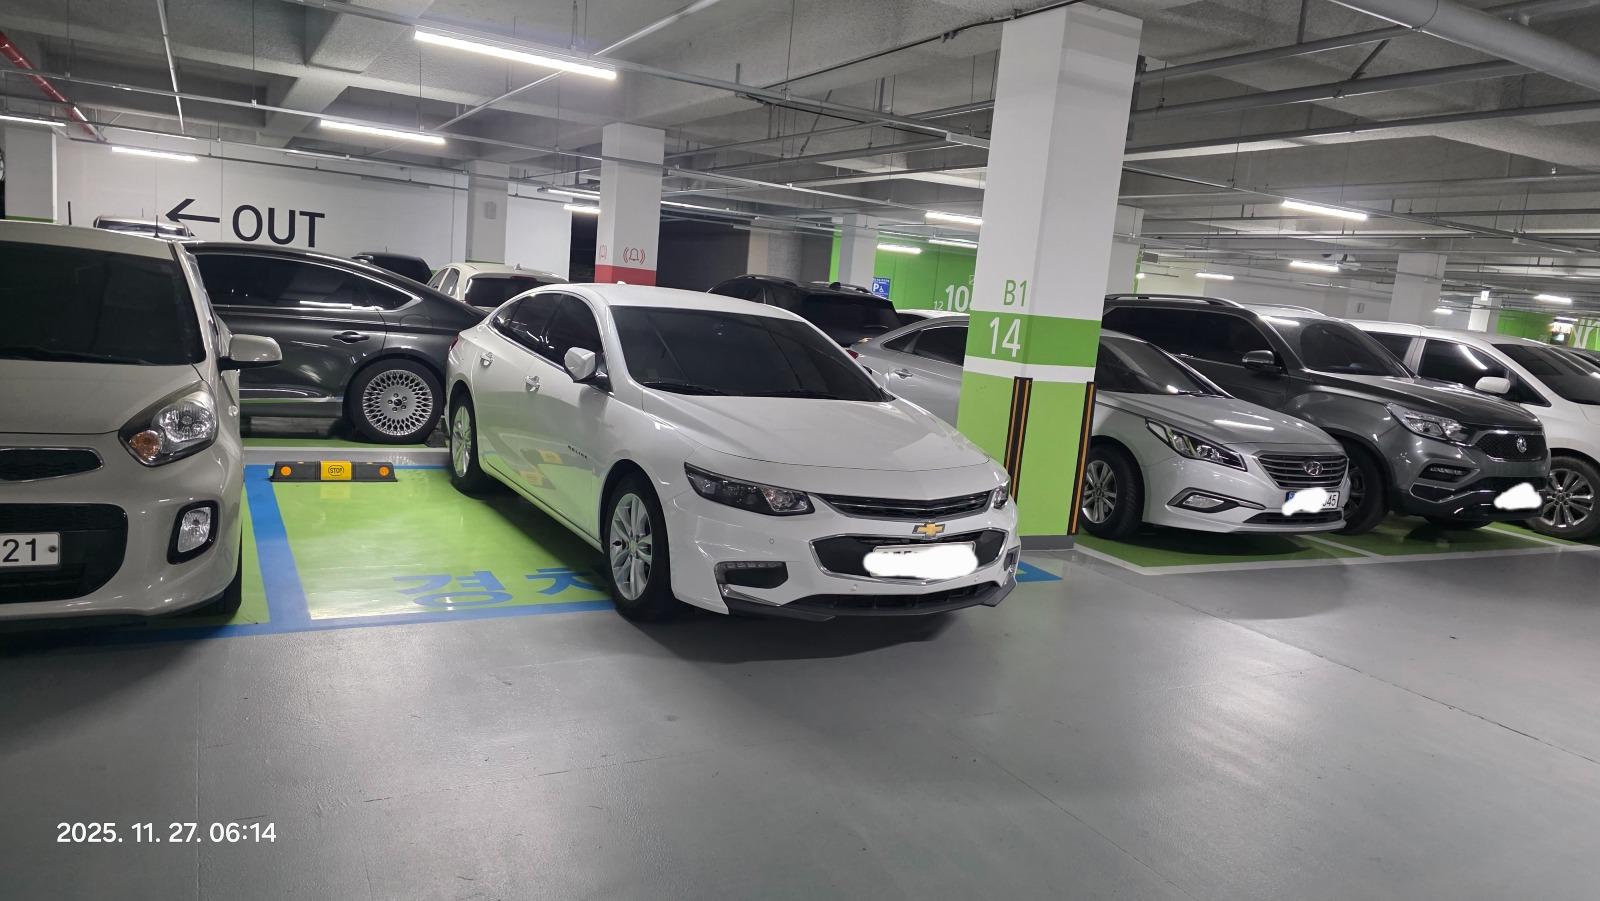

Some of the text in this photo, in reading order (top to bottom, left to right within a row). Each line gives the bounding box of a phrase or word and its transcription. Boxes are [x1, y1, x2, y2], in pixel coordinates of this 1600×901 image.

[232, 204, 325, 248] OUT
[872, 283, 880, 292] P
[1003, 279, 1028, 307] B1
[989, 316, 1021, 358] 14
[2, 537, 37, 563] 21
